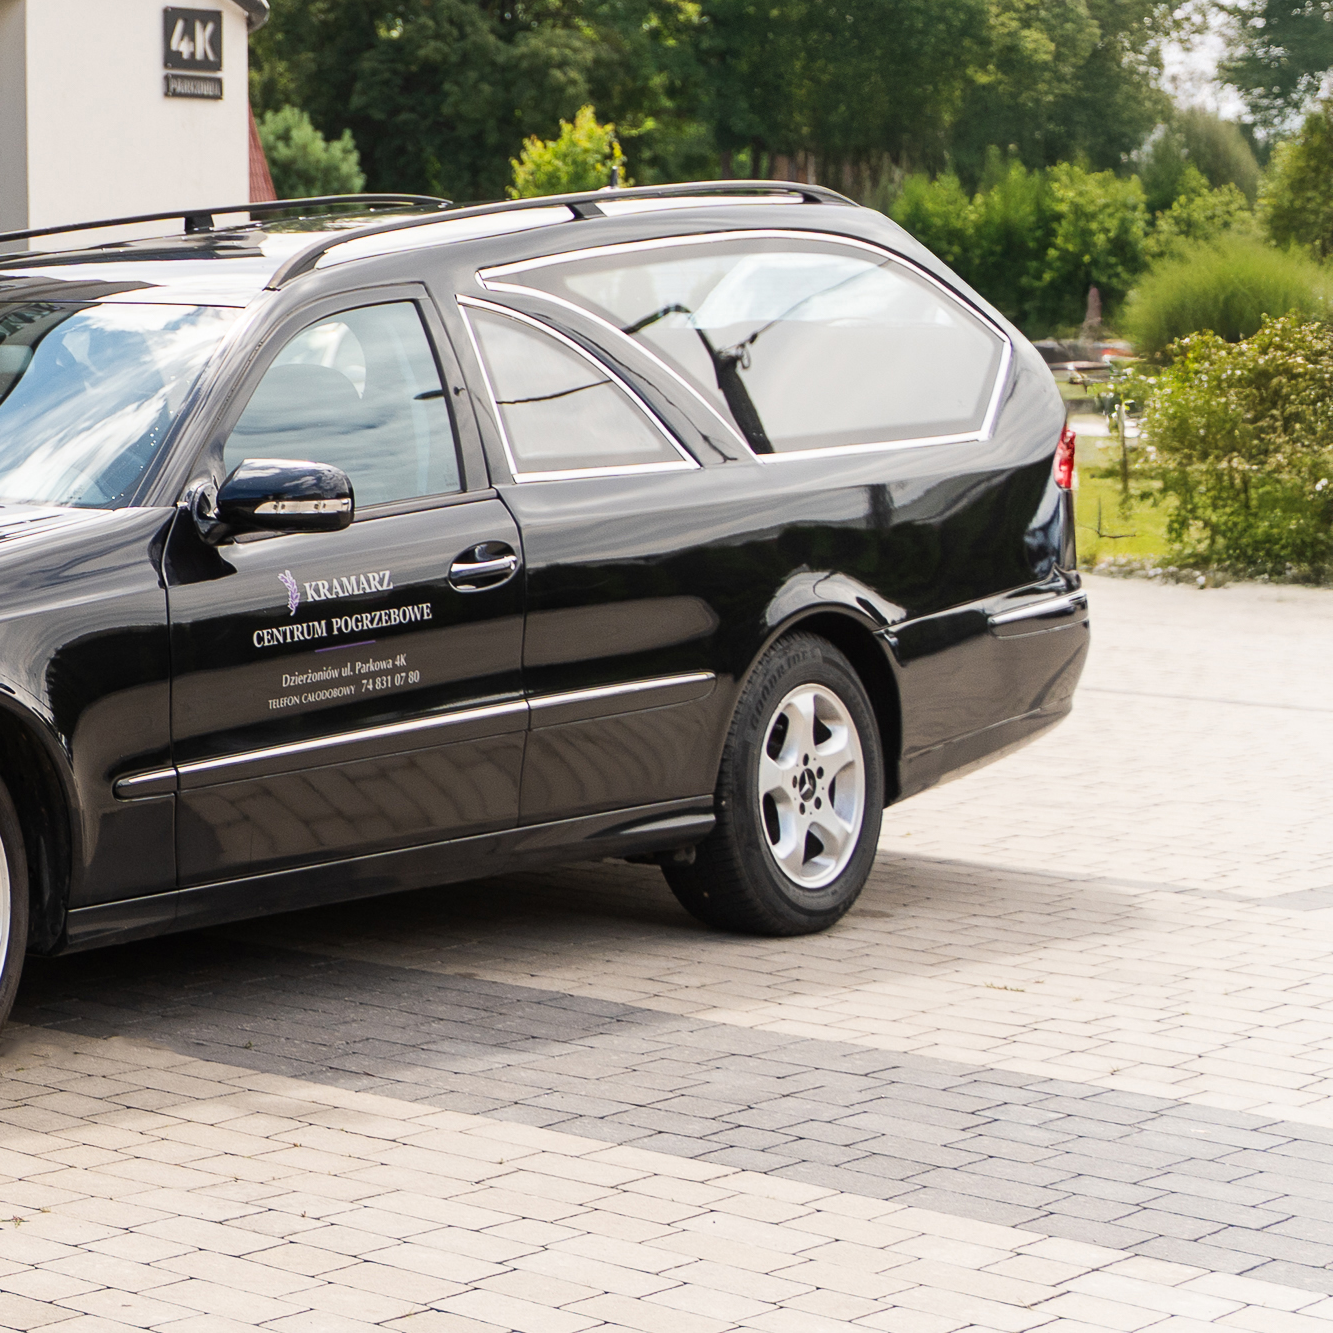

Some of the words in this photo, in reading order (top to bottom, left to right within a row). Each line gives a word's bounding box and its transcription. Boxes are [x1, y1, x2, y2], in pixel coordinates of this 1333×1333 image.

[170, 18, 218, 62] 4K
[303, 570, 394, 602] KRAMARZ
[252, 619, 328, 648] CENTRUM
[331, 603, 433, 635] POGRZEBOWE
[267, 694, 300, 710] TELEFON
[301, 685, 356, 704] CAŁODOBOWY
[361, 679, 374, 693] 74
[375, 675, 392, 690] 831
[394, 672, 407, 687] 07
[408, 670, 421, 684] 80
[282, 666, 340, 688] Dzierżoniów
[341, 662, 354, 677] ul.
[355, 658, 393, 674] Parkowa
[394, 653, 407, 667] 4K
